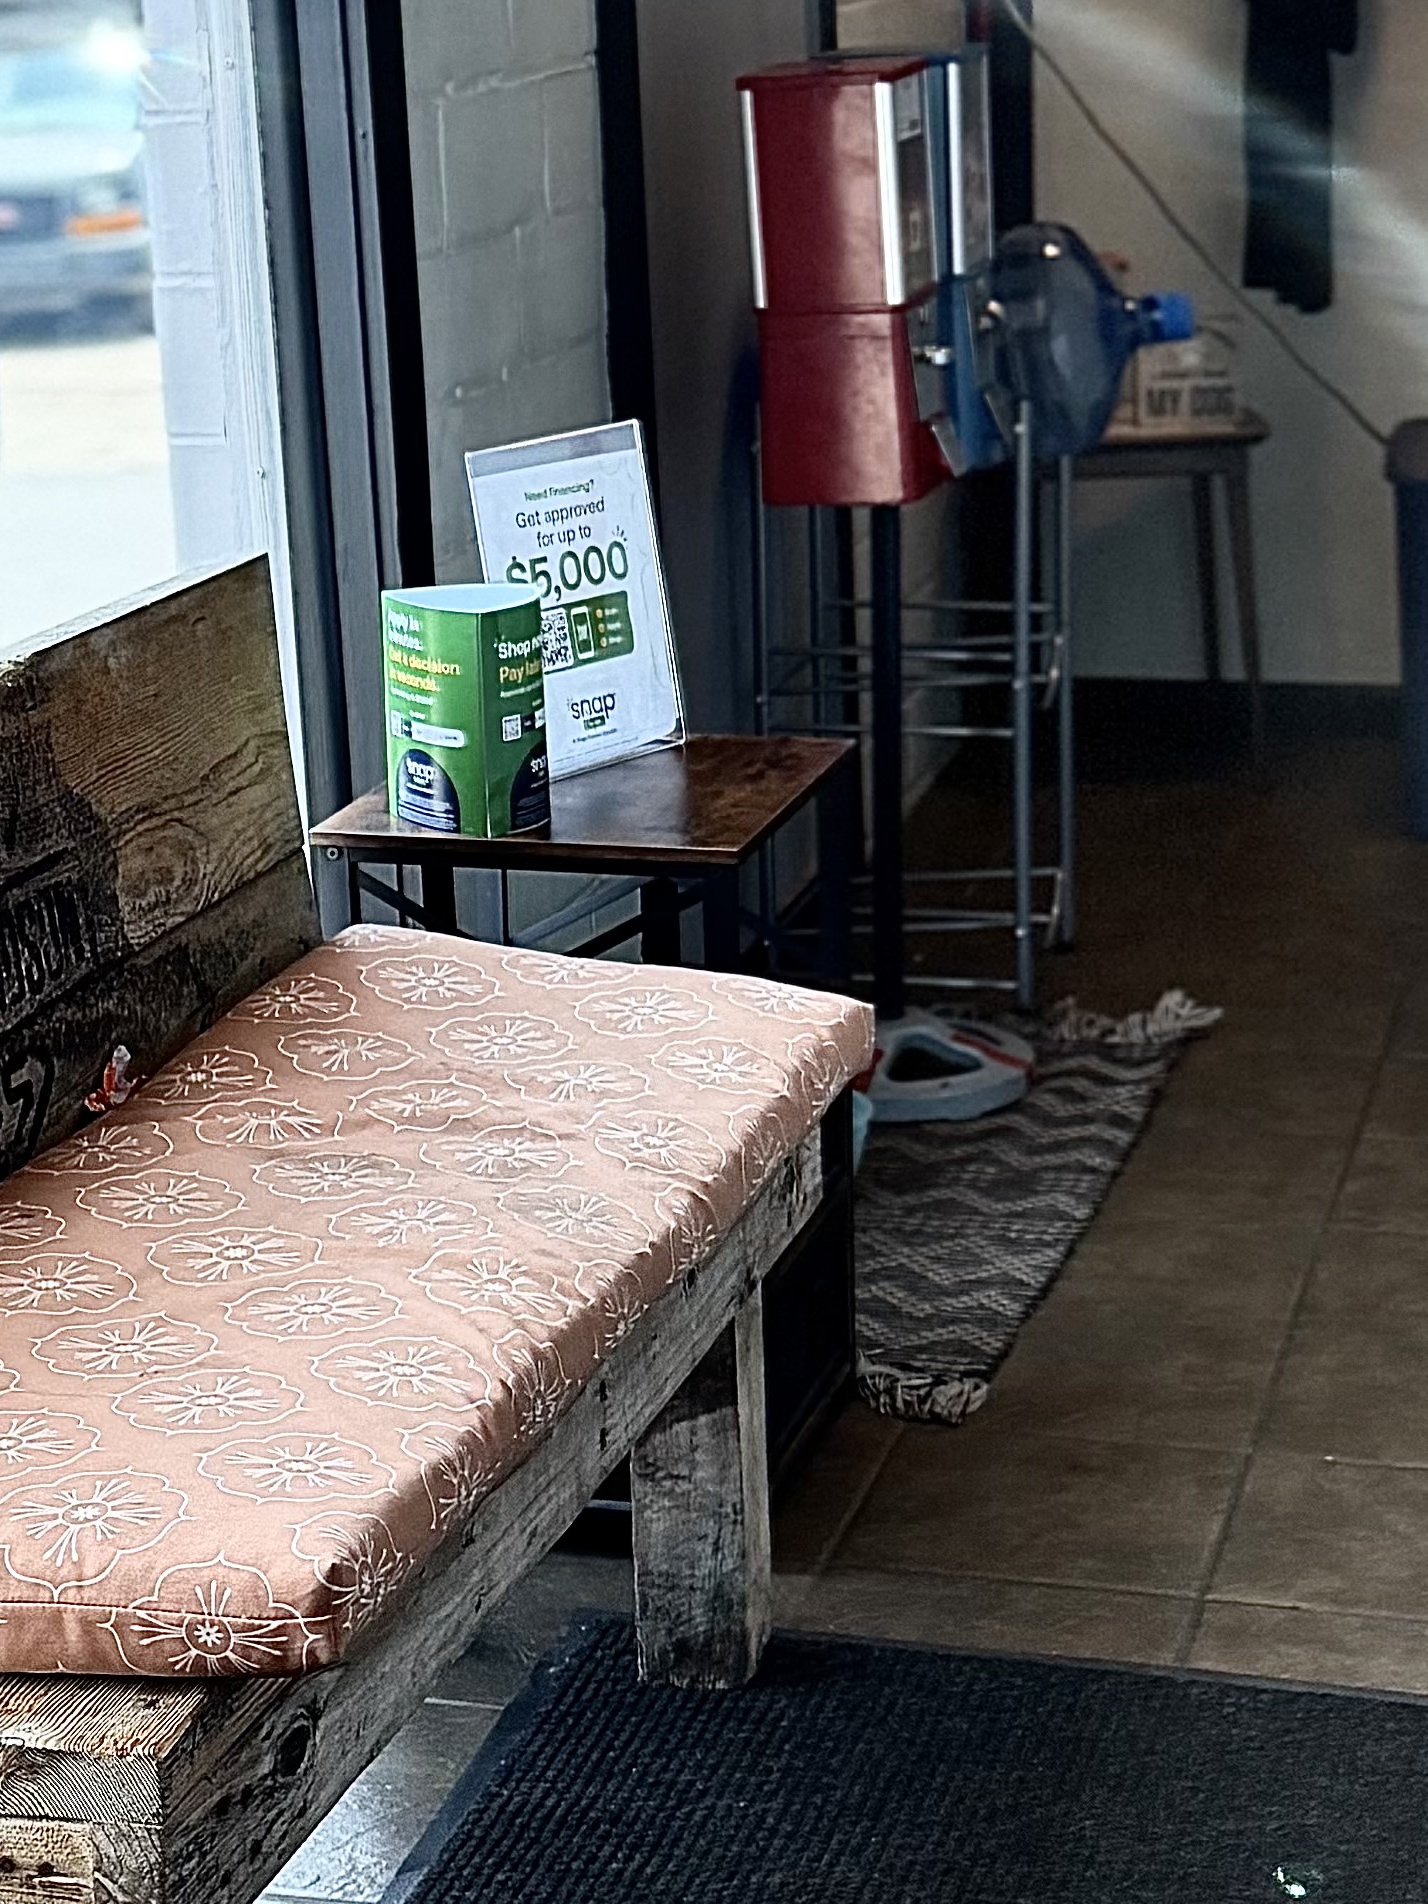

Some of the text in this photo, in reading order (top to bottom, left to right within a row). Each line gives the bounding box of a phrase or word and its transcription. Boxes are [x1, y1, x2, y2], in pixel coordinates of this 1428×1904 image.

[515, 496, 605, 528] Get approved
[537, 524, 591, 548] for up to
[505, 541, 628, 602] $5,000
[498, 642, 530, 659] Shop
[409, 654, 461, 675] decision
[499, 663, 523, 684] Pay
[569, 692, 616, 719] snap
